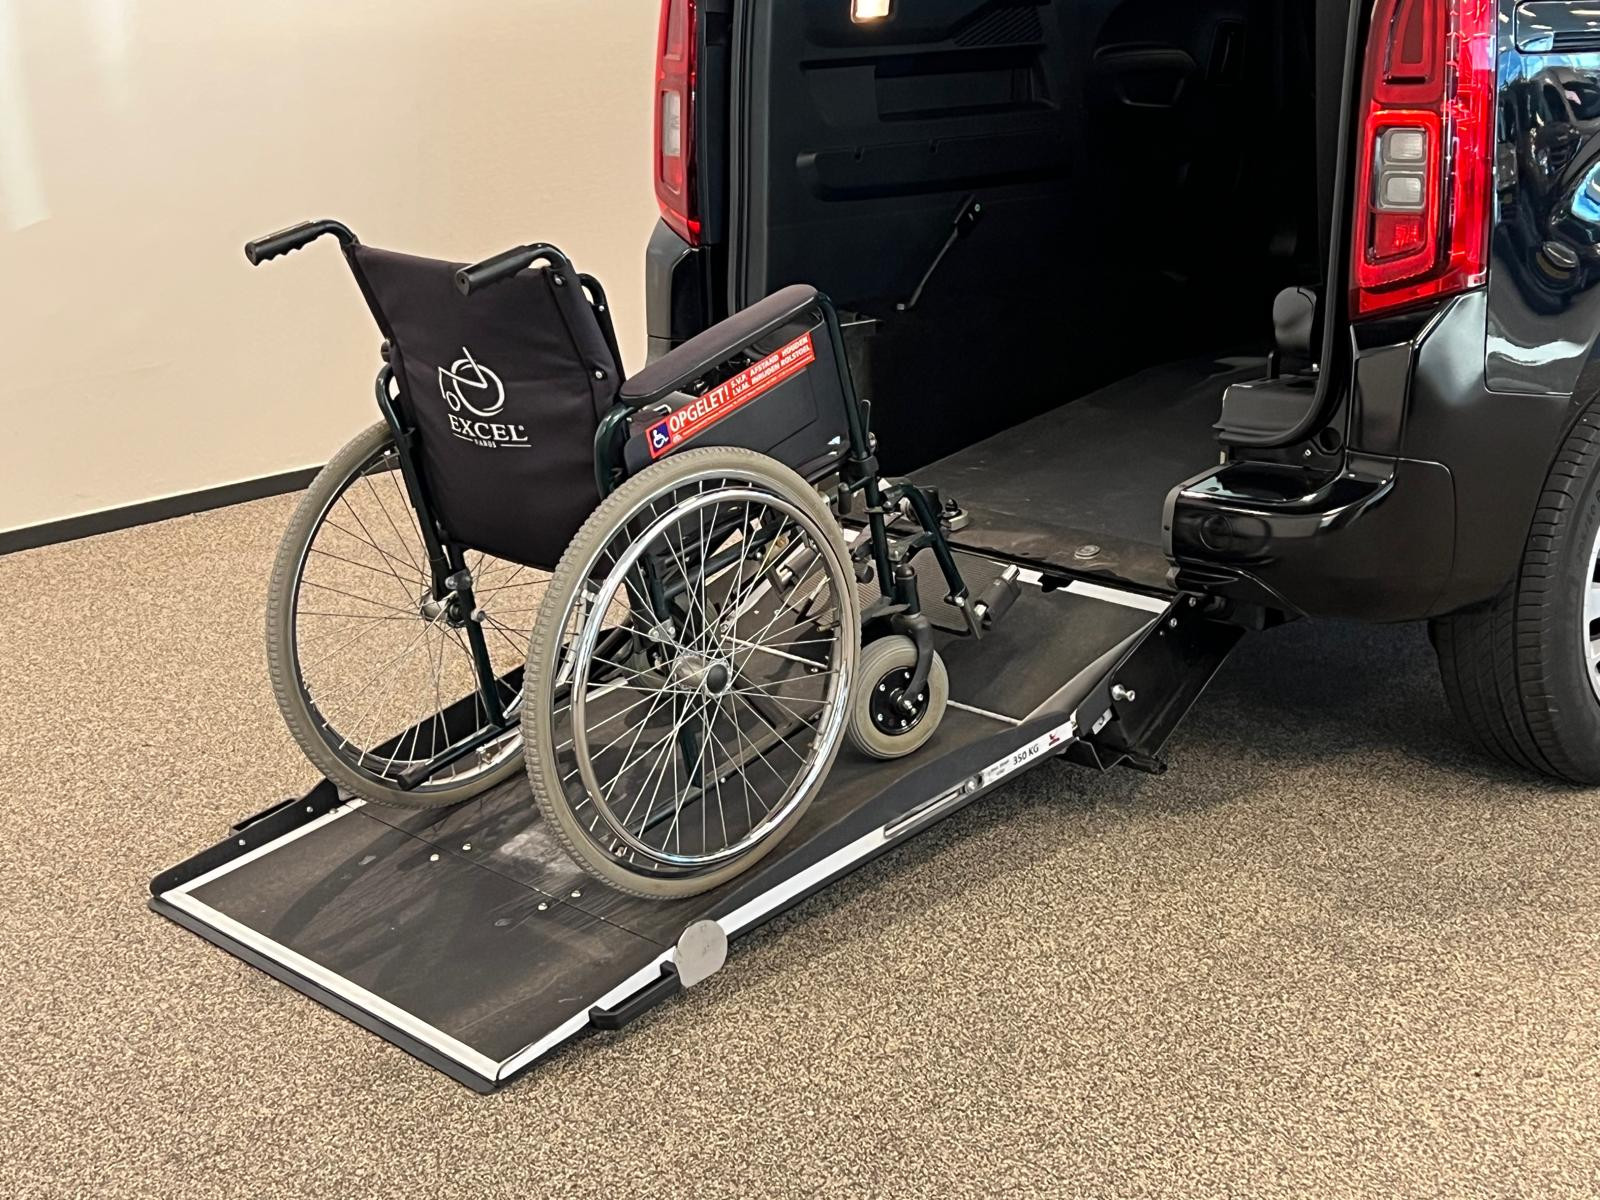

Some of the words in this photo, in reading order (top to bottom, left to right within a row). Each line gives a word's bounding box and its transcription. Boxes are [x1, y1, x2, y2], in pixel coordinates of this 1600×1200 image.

[750, 354, 780, 377] AFSTAND
[669, 384, 730, 433] OPGELET!
[1013, 751, 1028, 766] 350
[1028, 743, 1040, 758] KG
